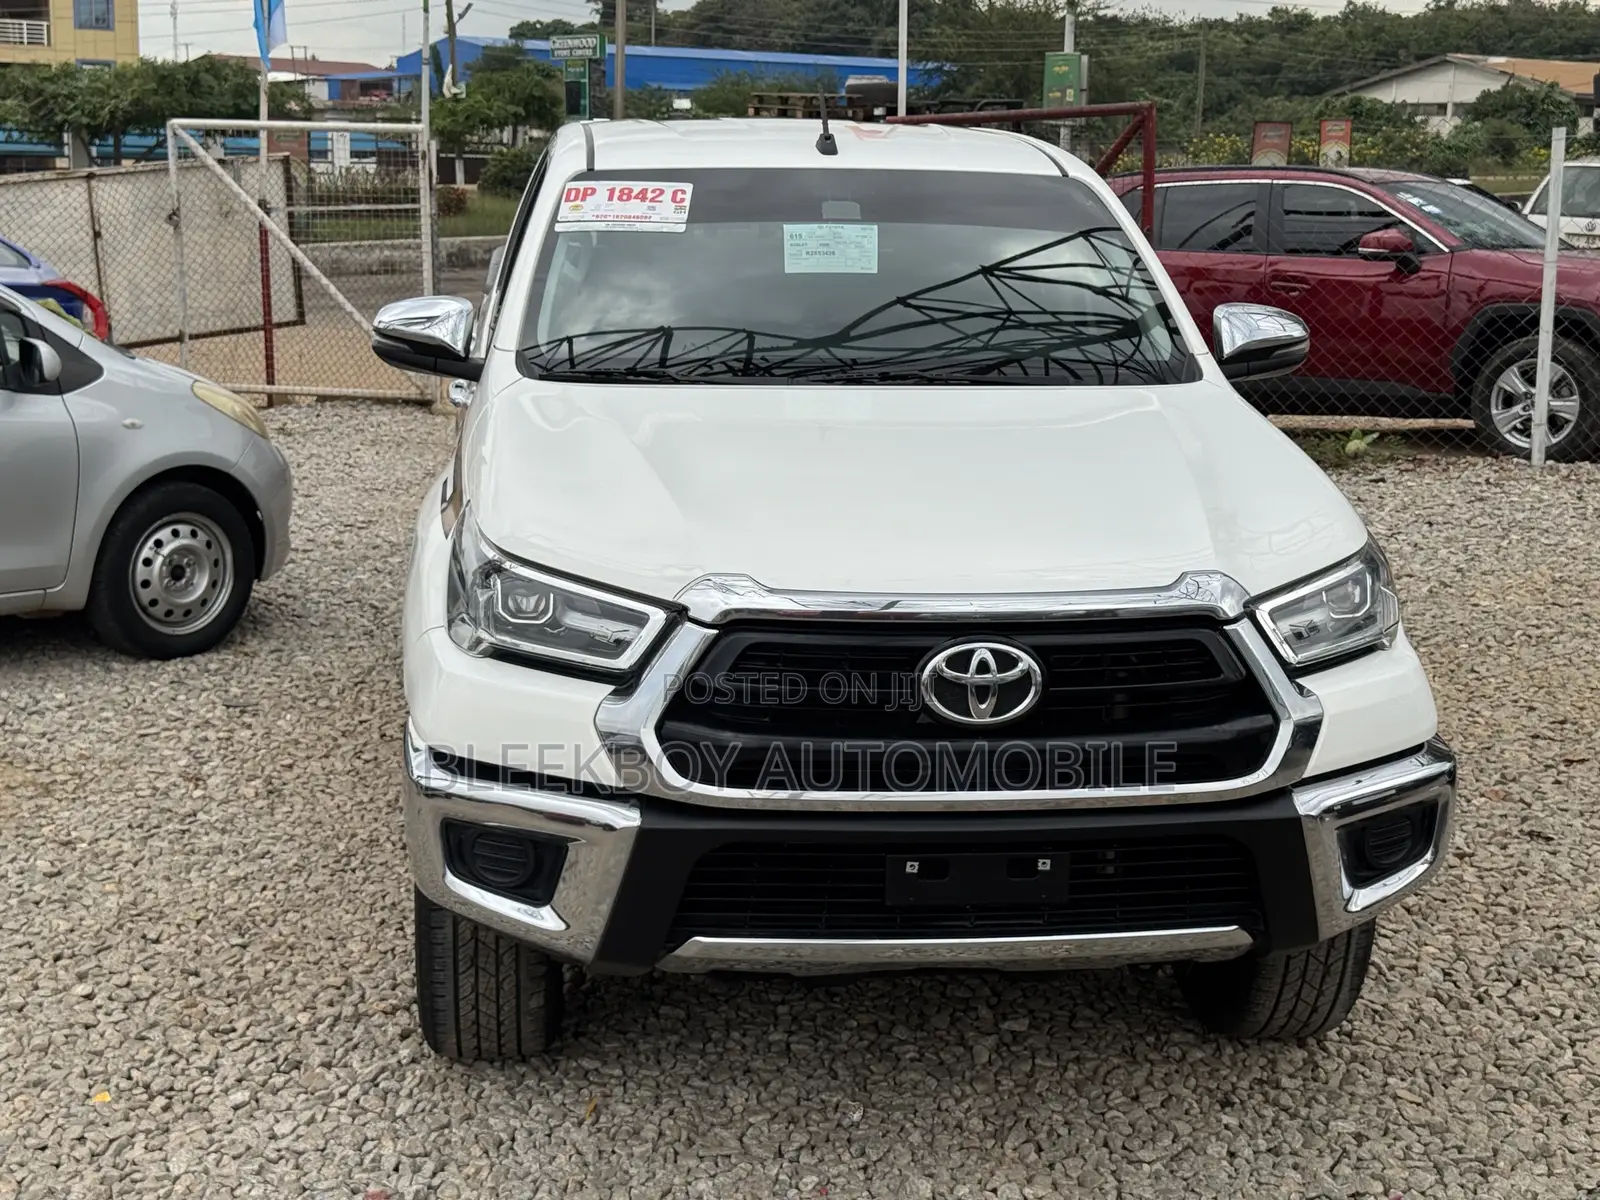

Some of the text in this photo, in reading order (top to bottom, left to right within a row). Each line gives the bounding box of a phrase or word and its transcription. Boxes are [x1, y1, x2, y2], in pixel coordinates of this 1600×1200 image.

[551, 37, 596, 49] GREENWOOD
[564, 187, 687, 204] DP 1842 C
